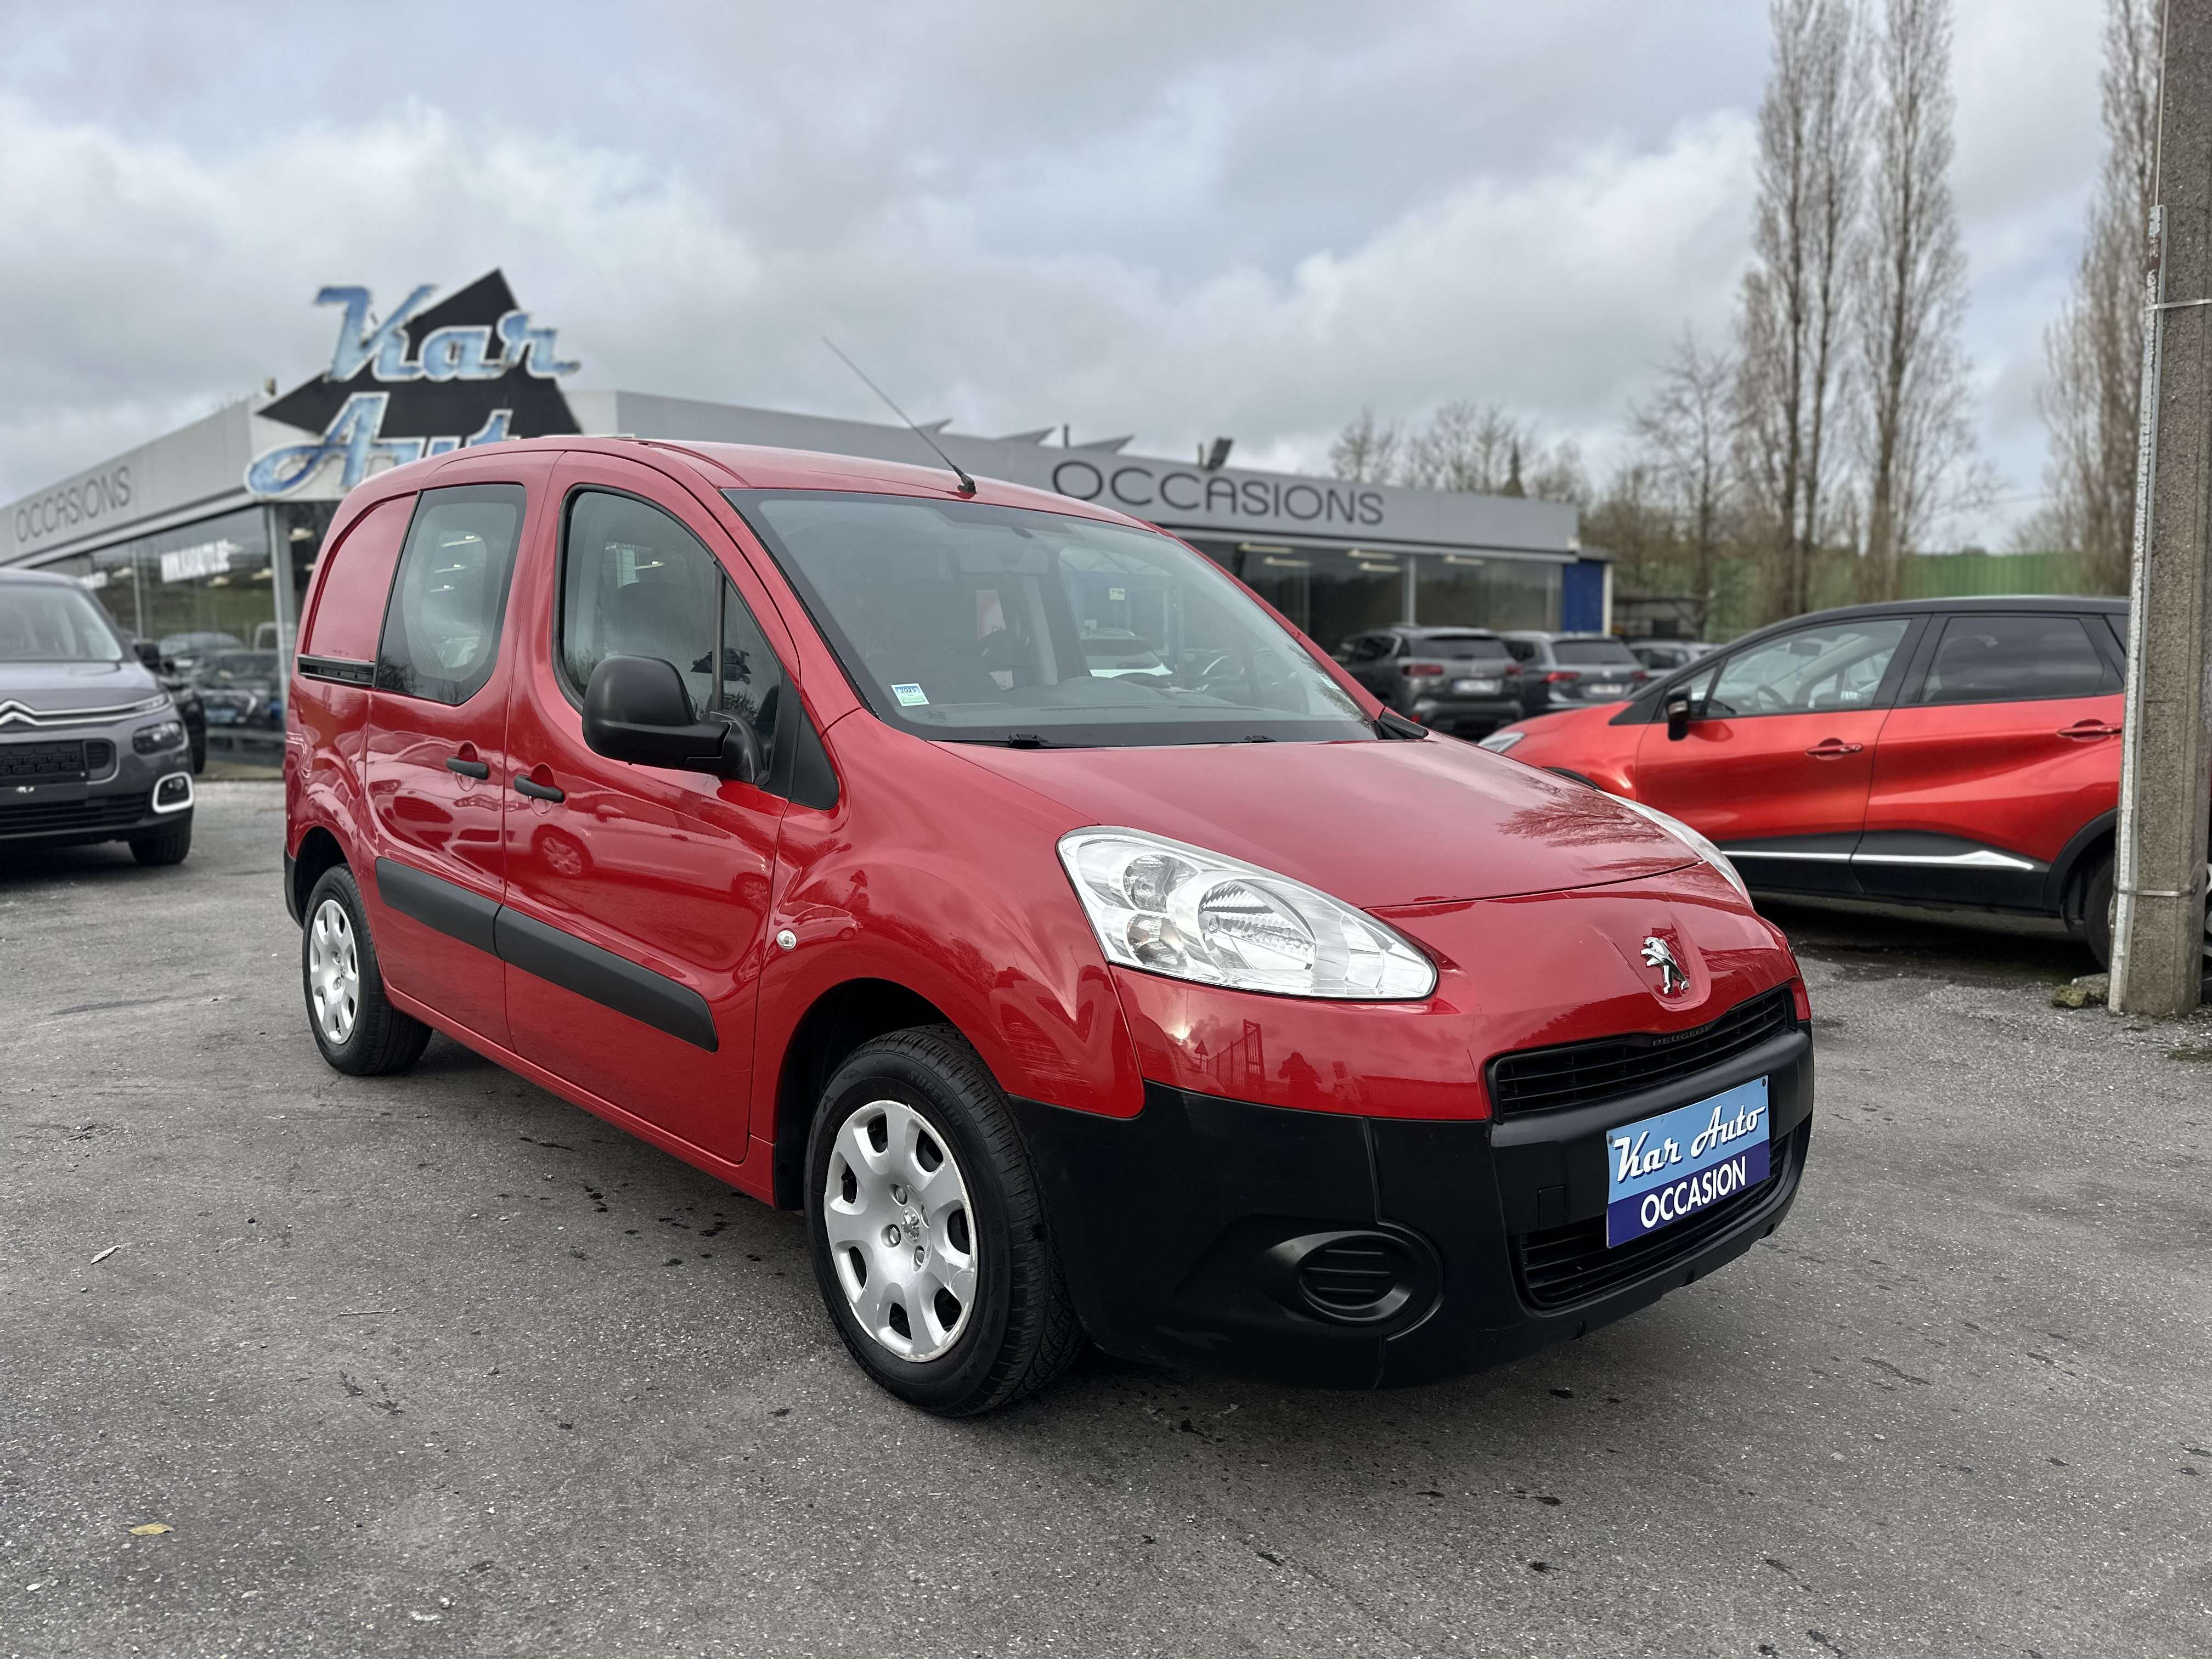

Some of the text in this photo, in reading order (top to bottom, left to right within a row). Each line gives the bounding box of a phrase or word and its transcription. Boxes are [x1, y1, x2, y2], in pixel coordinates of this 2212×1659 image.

[313, 284, 581, 382] Kar
[15, 465, 132, 543] OCCASIONS
[1052, 460, 1384, 525] OCCASIONS
[1613, 1104, 1766, 1184] Kar Auto
[1640, 1155, 1746, 1228] OCCASION
